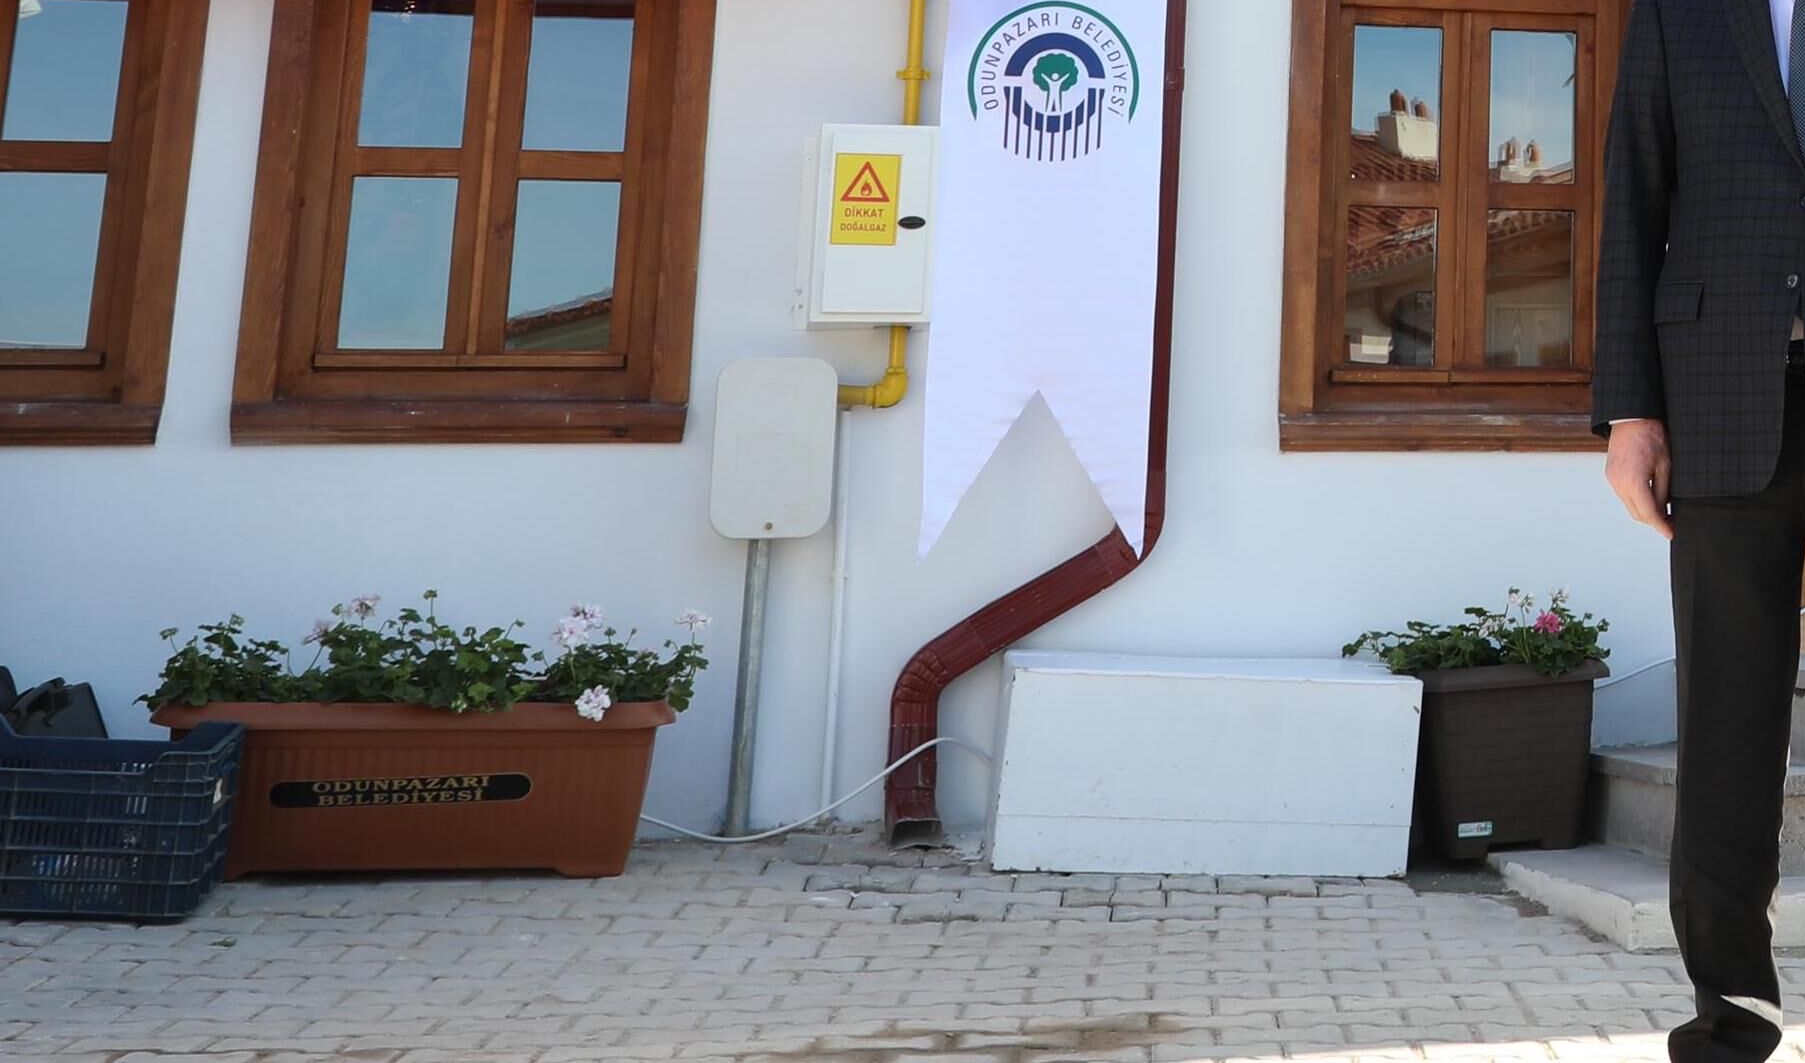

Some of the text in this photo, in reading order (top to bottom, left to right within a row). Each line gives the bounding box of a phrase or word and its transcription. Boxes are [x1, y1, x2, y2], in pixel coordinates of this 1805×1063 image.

[981, 12, 1129, 117] ODUNPAZARI BELEDİYESİ
[844, 205, 885, 218] DİKKAT
[840, 221, 887, 232] DOĞALGAZ
[312, 776, 490, 793] ODUNPAZARI
[317, 788, 484, 806] BELEDİYESİ
